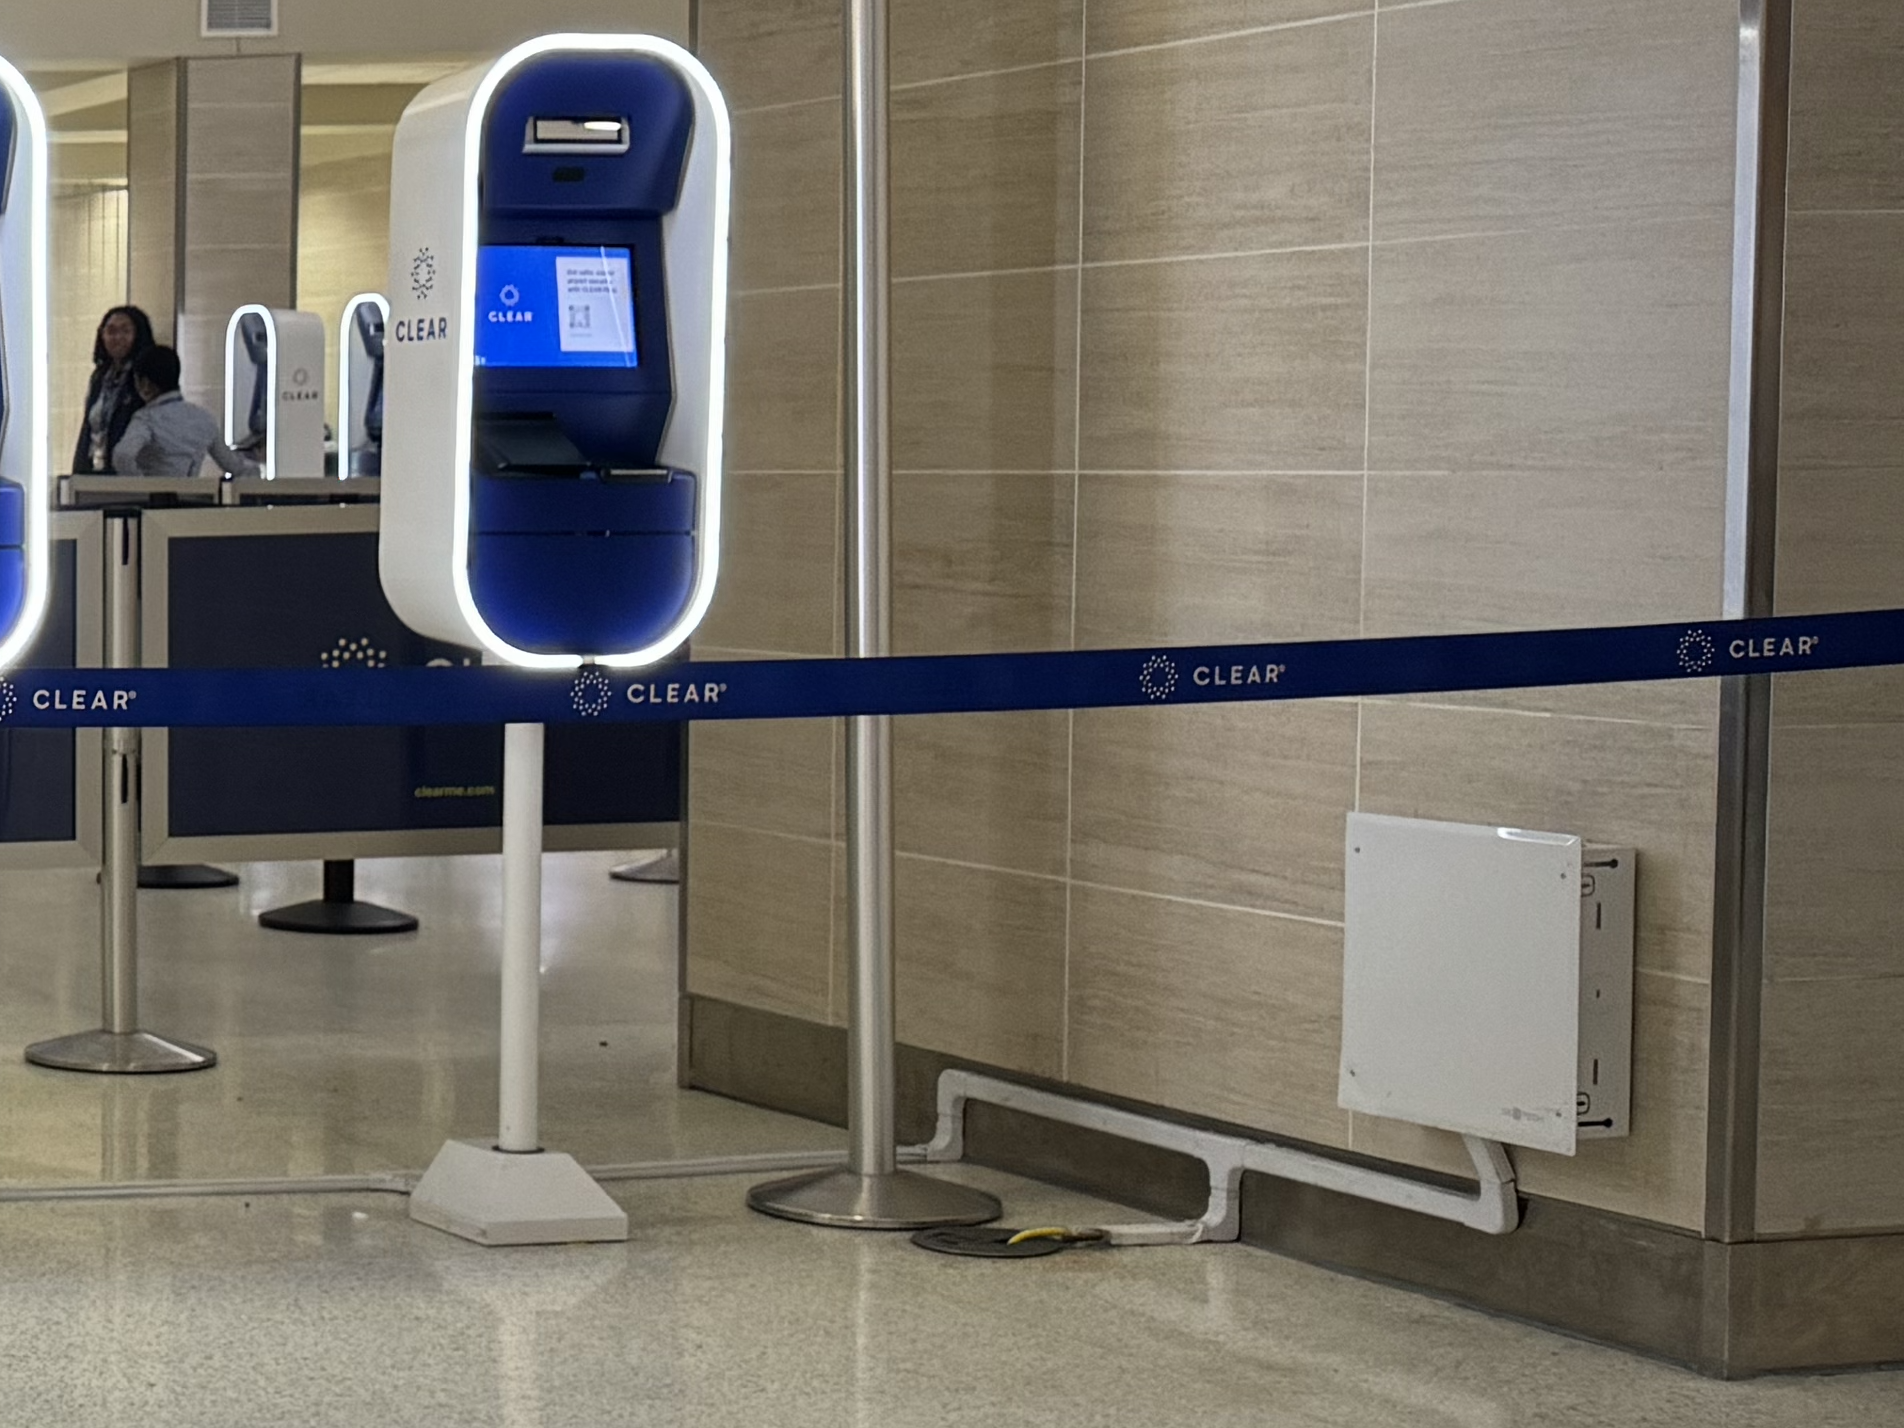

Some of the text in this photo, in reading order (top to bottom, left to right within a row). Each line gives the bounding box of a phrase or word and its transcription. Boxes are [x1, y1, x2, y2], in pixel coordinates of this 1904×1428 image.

[488, 310, 533, 323] CLEAR
[395, 316, 448, 343] CLEAR
[282, 390, 319, 402] CLEAR
